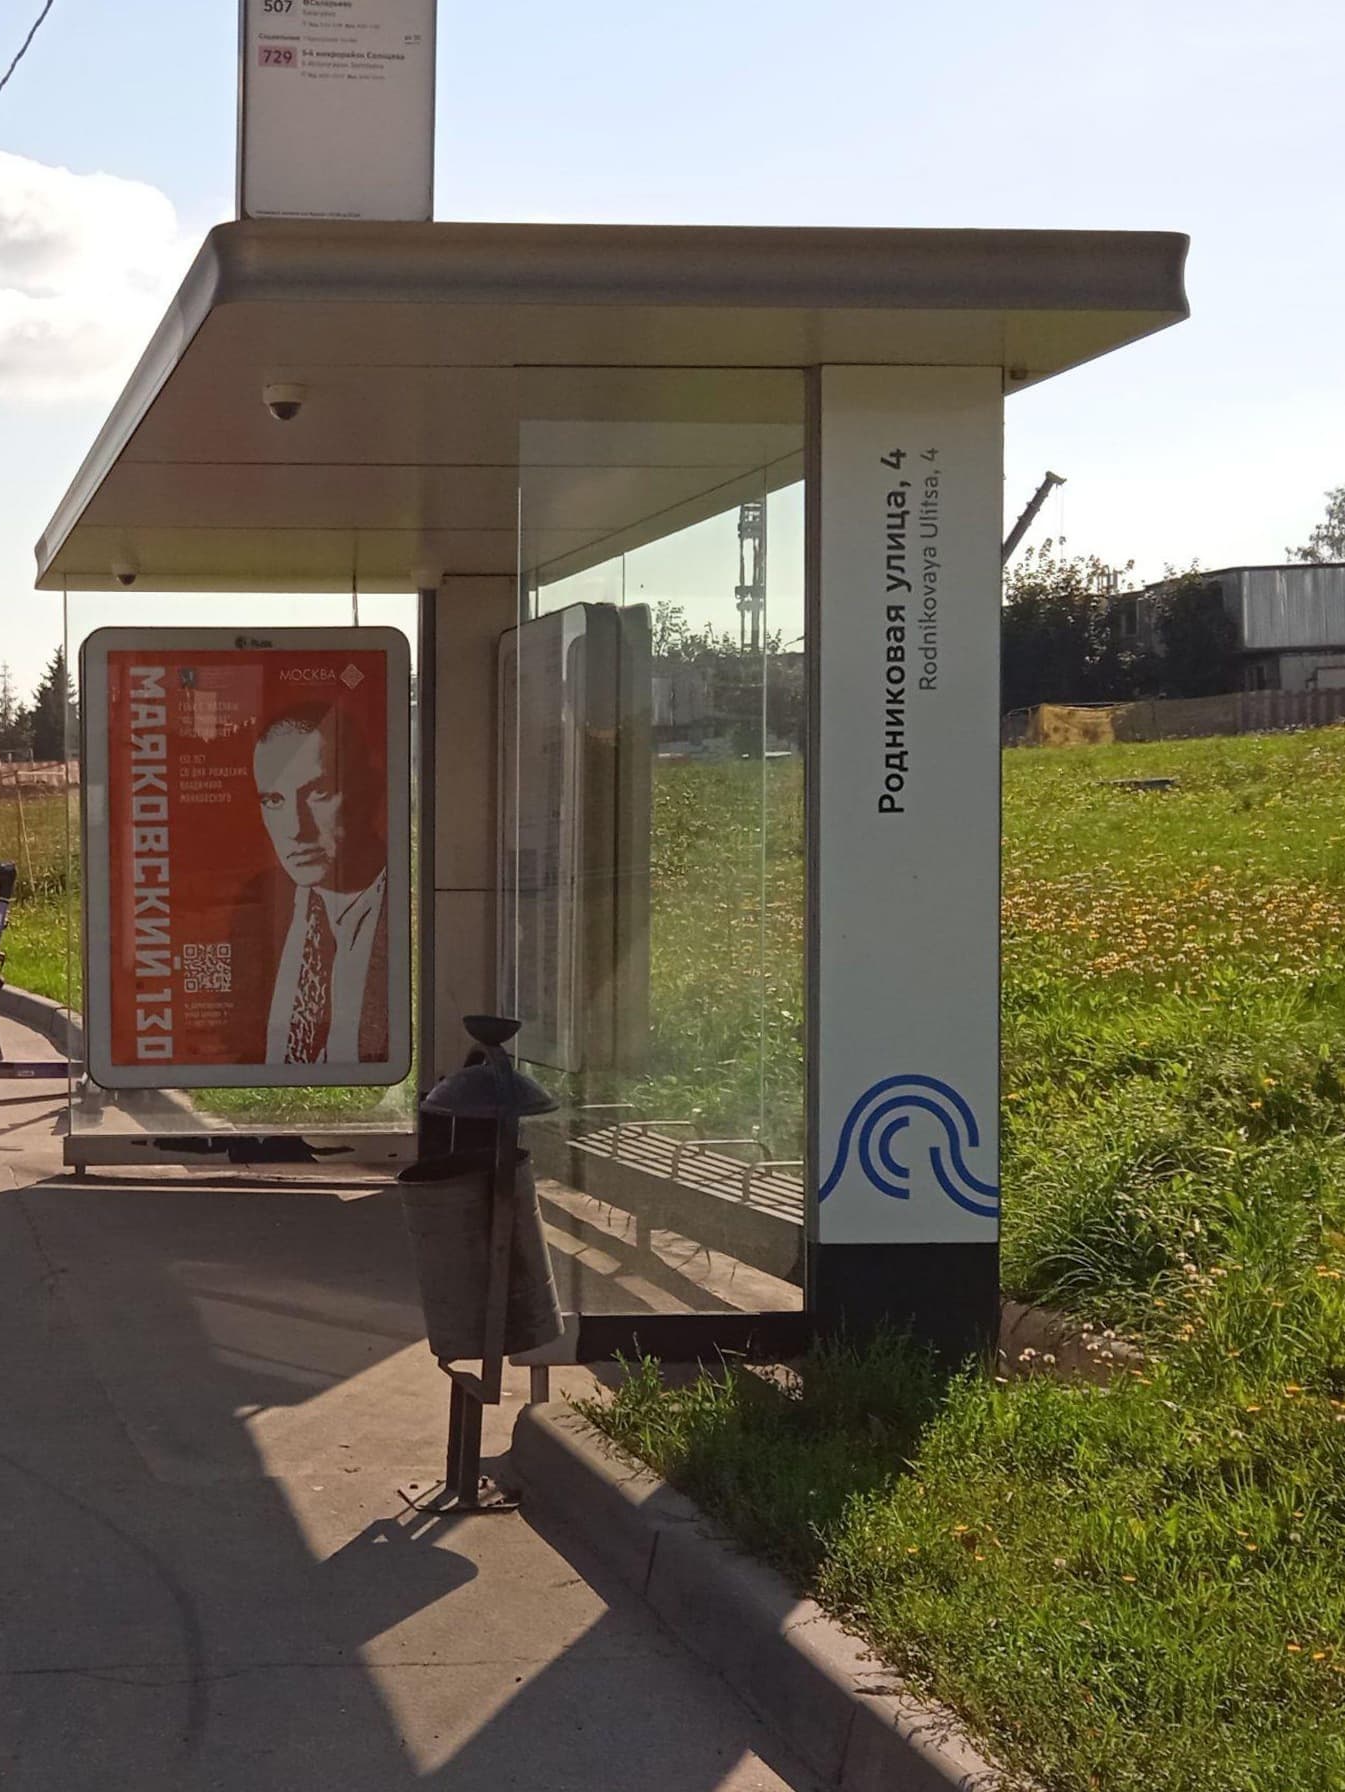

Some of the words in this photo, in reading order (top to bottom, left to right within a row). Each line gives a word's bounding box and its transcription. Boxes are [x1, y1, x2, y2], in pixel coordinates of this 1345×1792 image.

[263, 0, 293, 13] 507
[263, 49, 293, 64] 729
[880, 448, 907, 470] 4
[920, 447, 940, 461] 4
[885, 481, 912, 593] улица,
[919, 470, 941, 540] Ulitsa,
[918, 545, 942, 691] Rodnikovaya
[279, 669, 337, 681] МОСКВА
[878, 604, 909, 814] Родниковая
[129, 666, 181, 978] МАЯКОВСКИЙ
[136, 987, 173, 1060] 130
